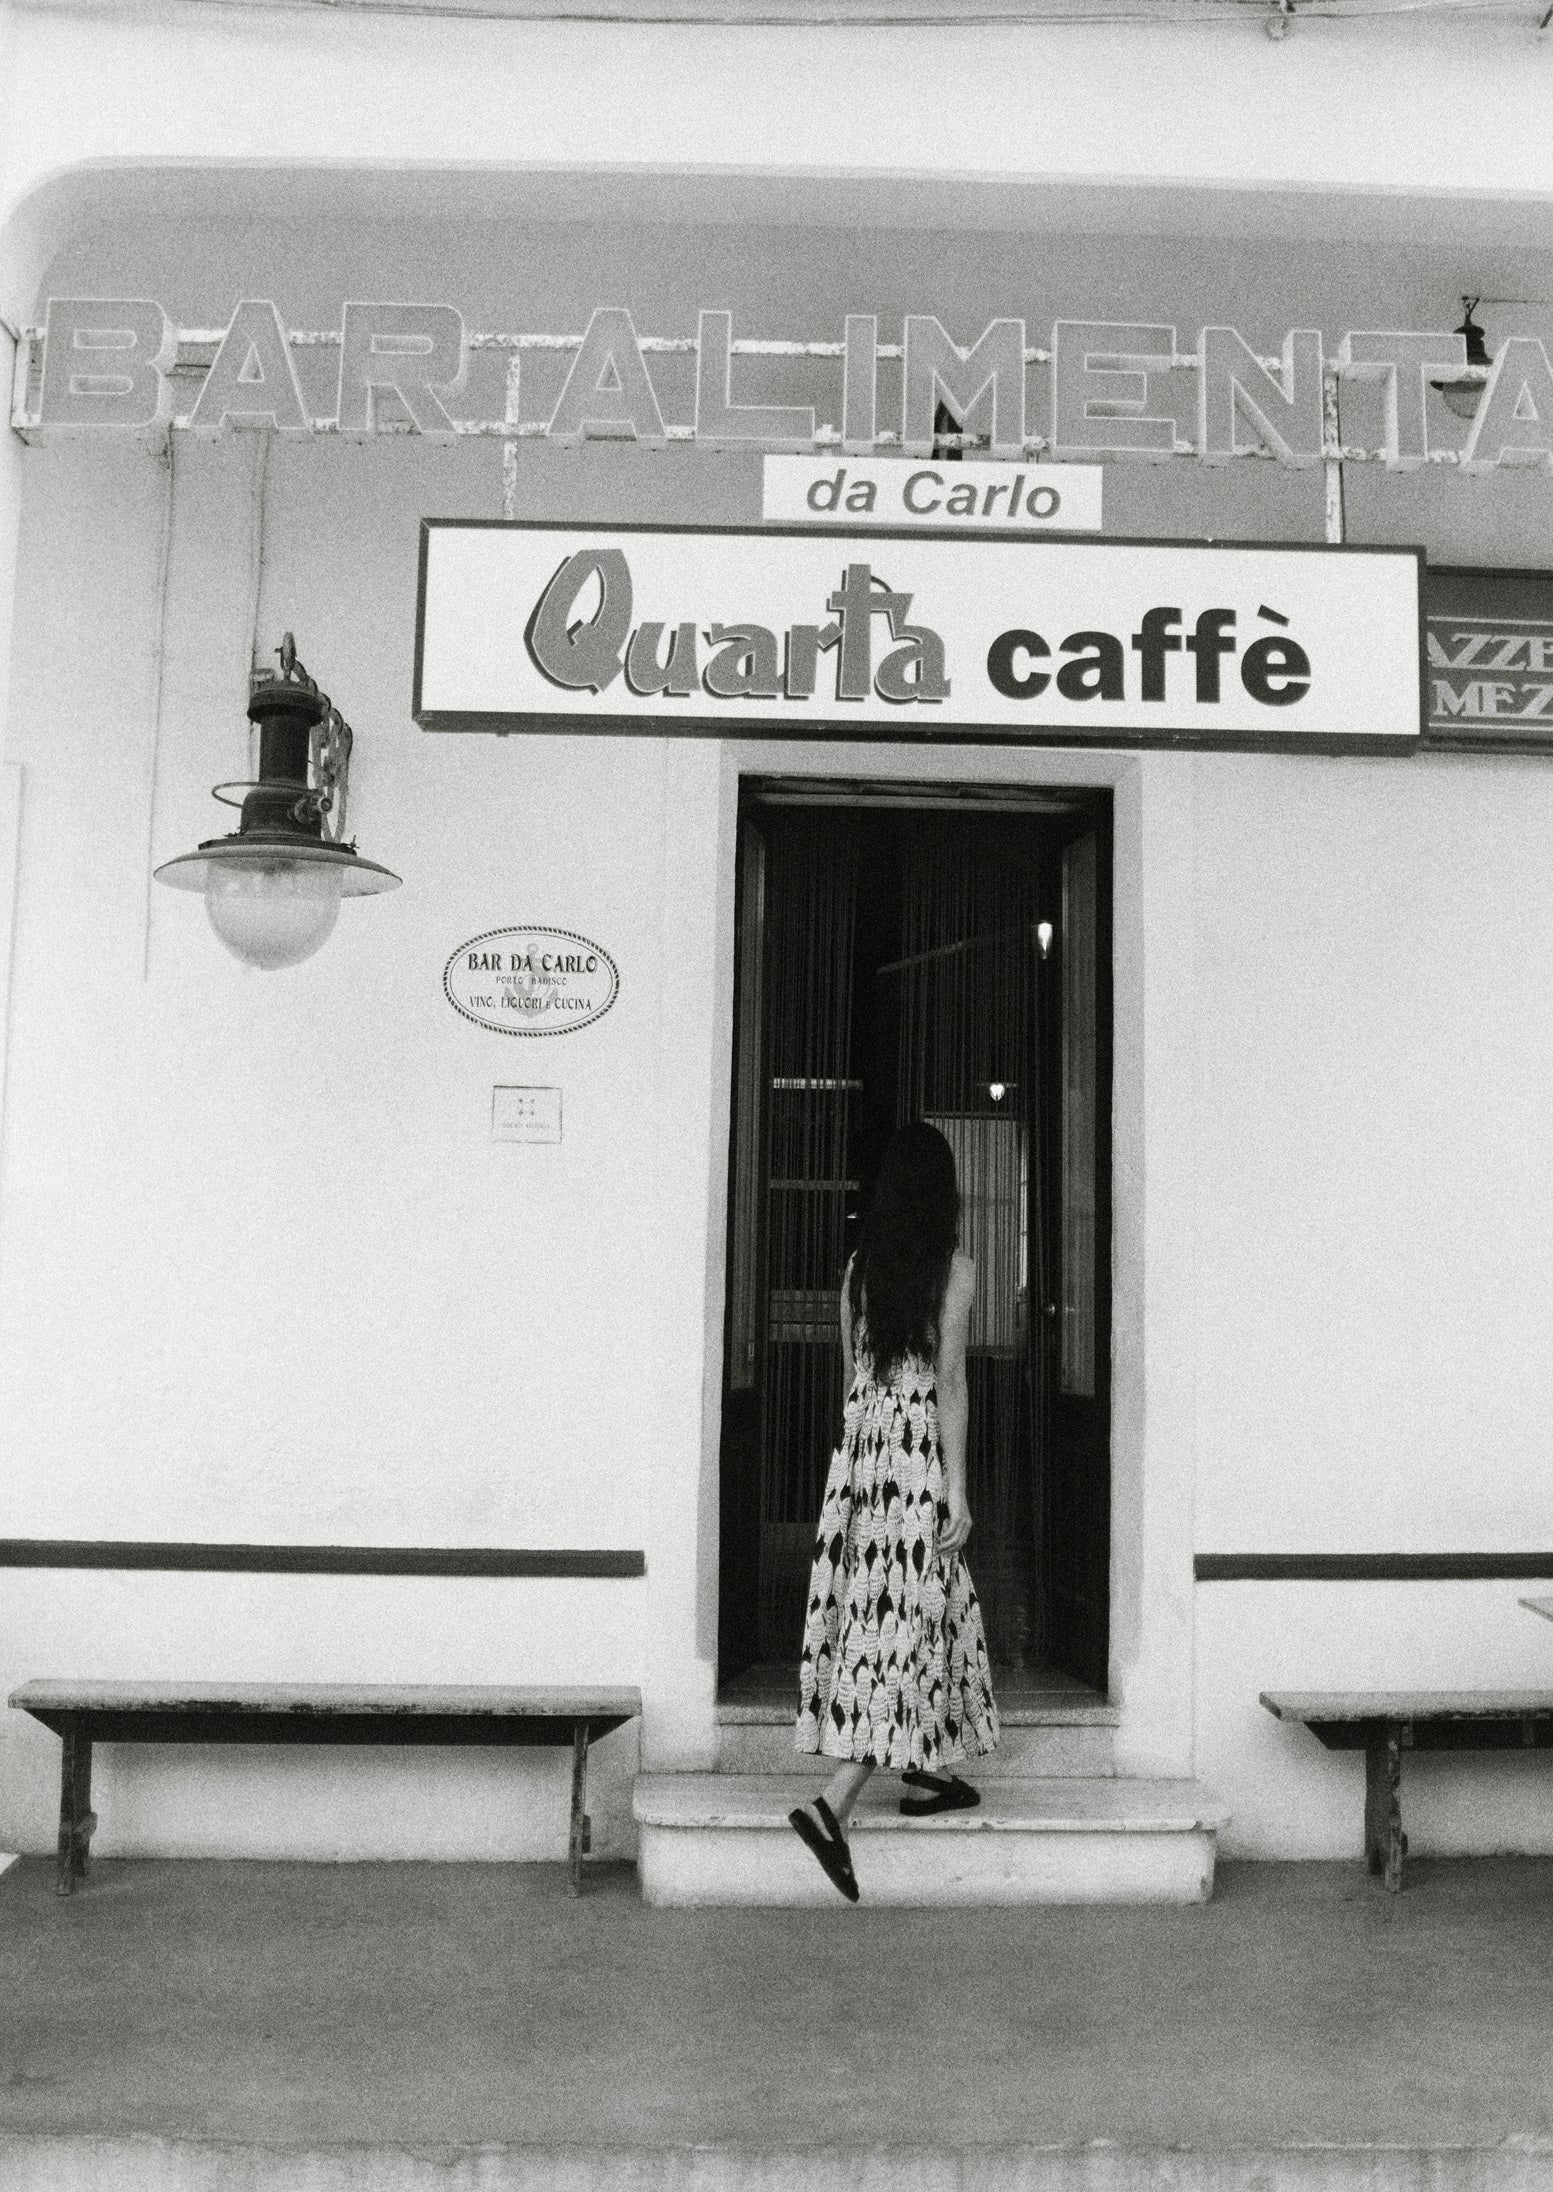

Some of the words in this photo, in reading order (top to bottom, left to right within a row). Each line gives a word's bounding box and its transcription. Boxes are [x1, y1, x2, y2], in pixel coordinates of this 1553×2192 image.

[39, 297, 464, 436] BAR
[547, 307, 1553, 476] ALIMENTA
[806, 469, 878, 513] da
[903, 471, 1062, 519] Carlo
[525, 548, 951, 703] Quarta
[987, 604, 1312, 706] caffè
[468, 952, 501, 972] BAR
[511, 953, 533, 972] DA
[542, 953, 598, 973] CARLO
